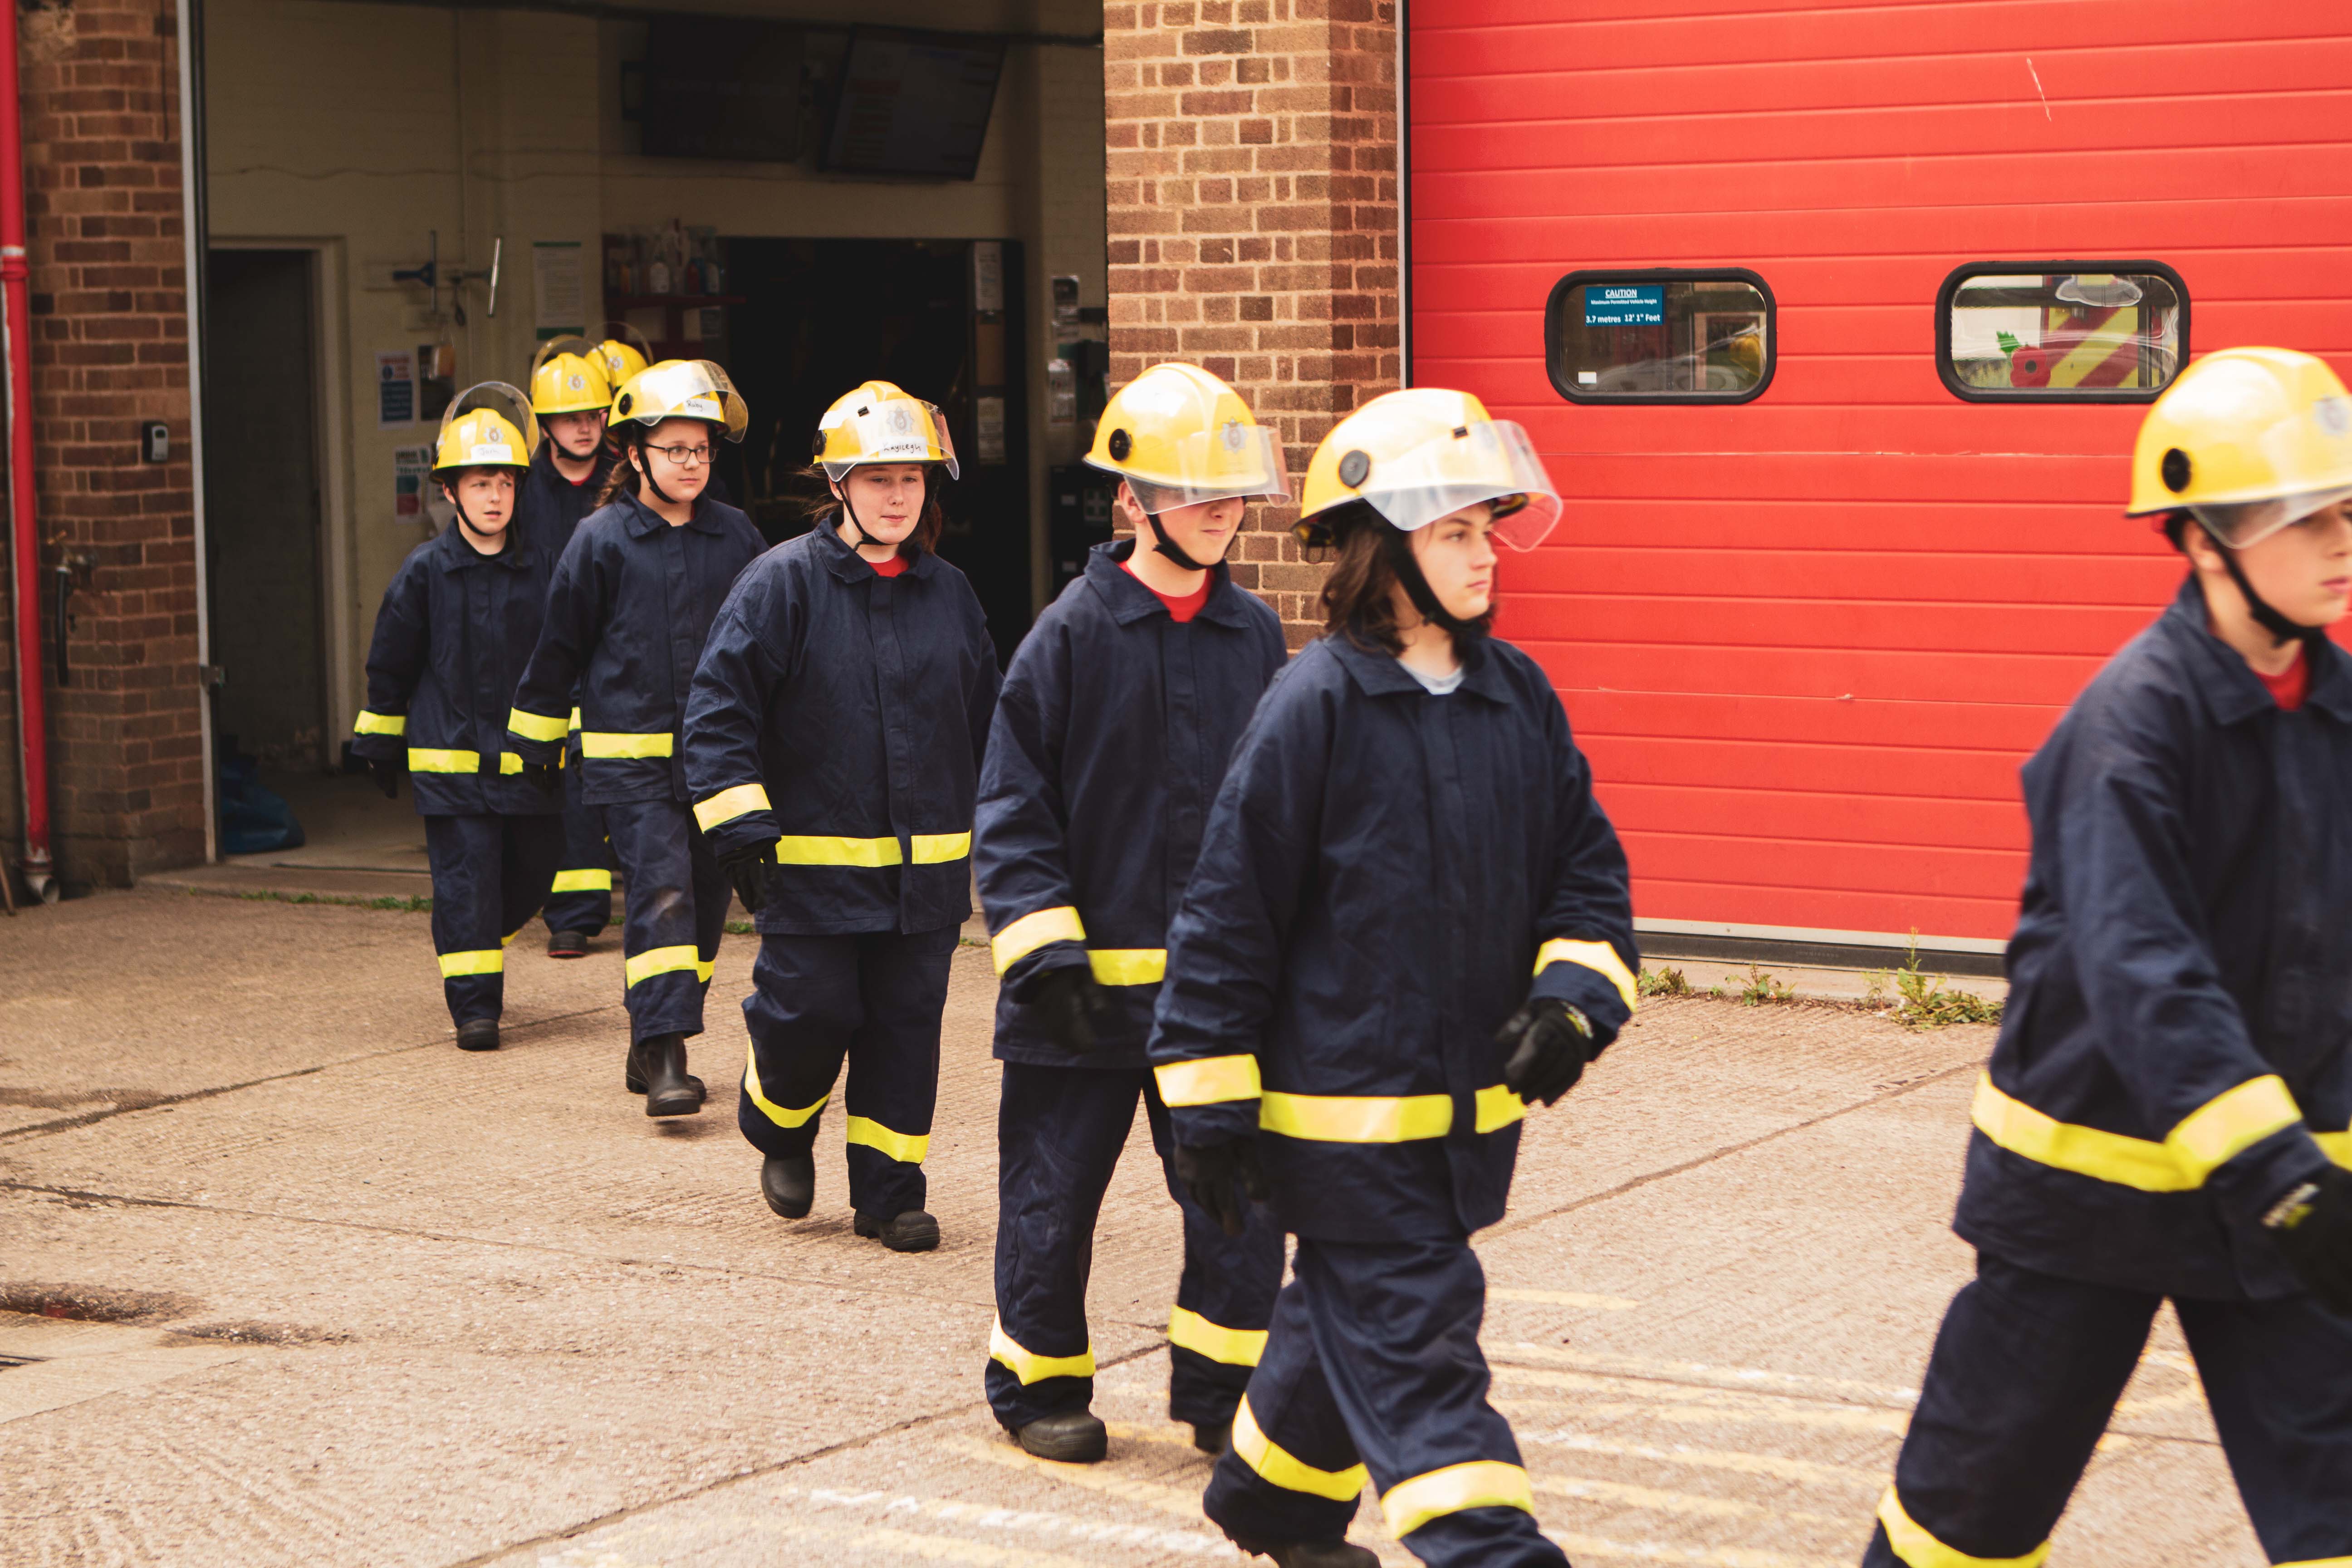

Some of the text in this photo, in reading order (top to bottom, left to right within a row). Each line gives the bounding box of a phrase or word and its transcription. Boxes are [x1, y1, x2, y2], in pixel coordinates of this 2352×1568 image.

[1605, 289, 1637, 298] CAUTION
[1586, 315, 1597, 323] 3.7
[1625, 314, 1635, 322] 12'
[1645, 314, 1661, 322] Feet
[686, 399, 703, 412] Ruby
